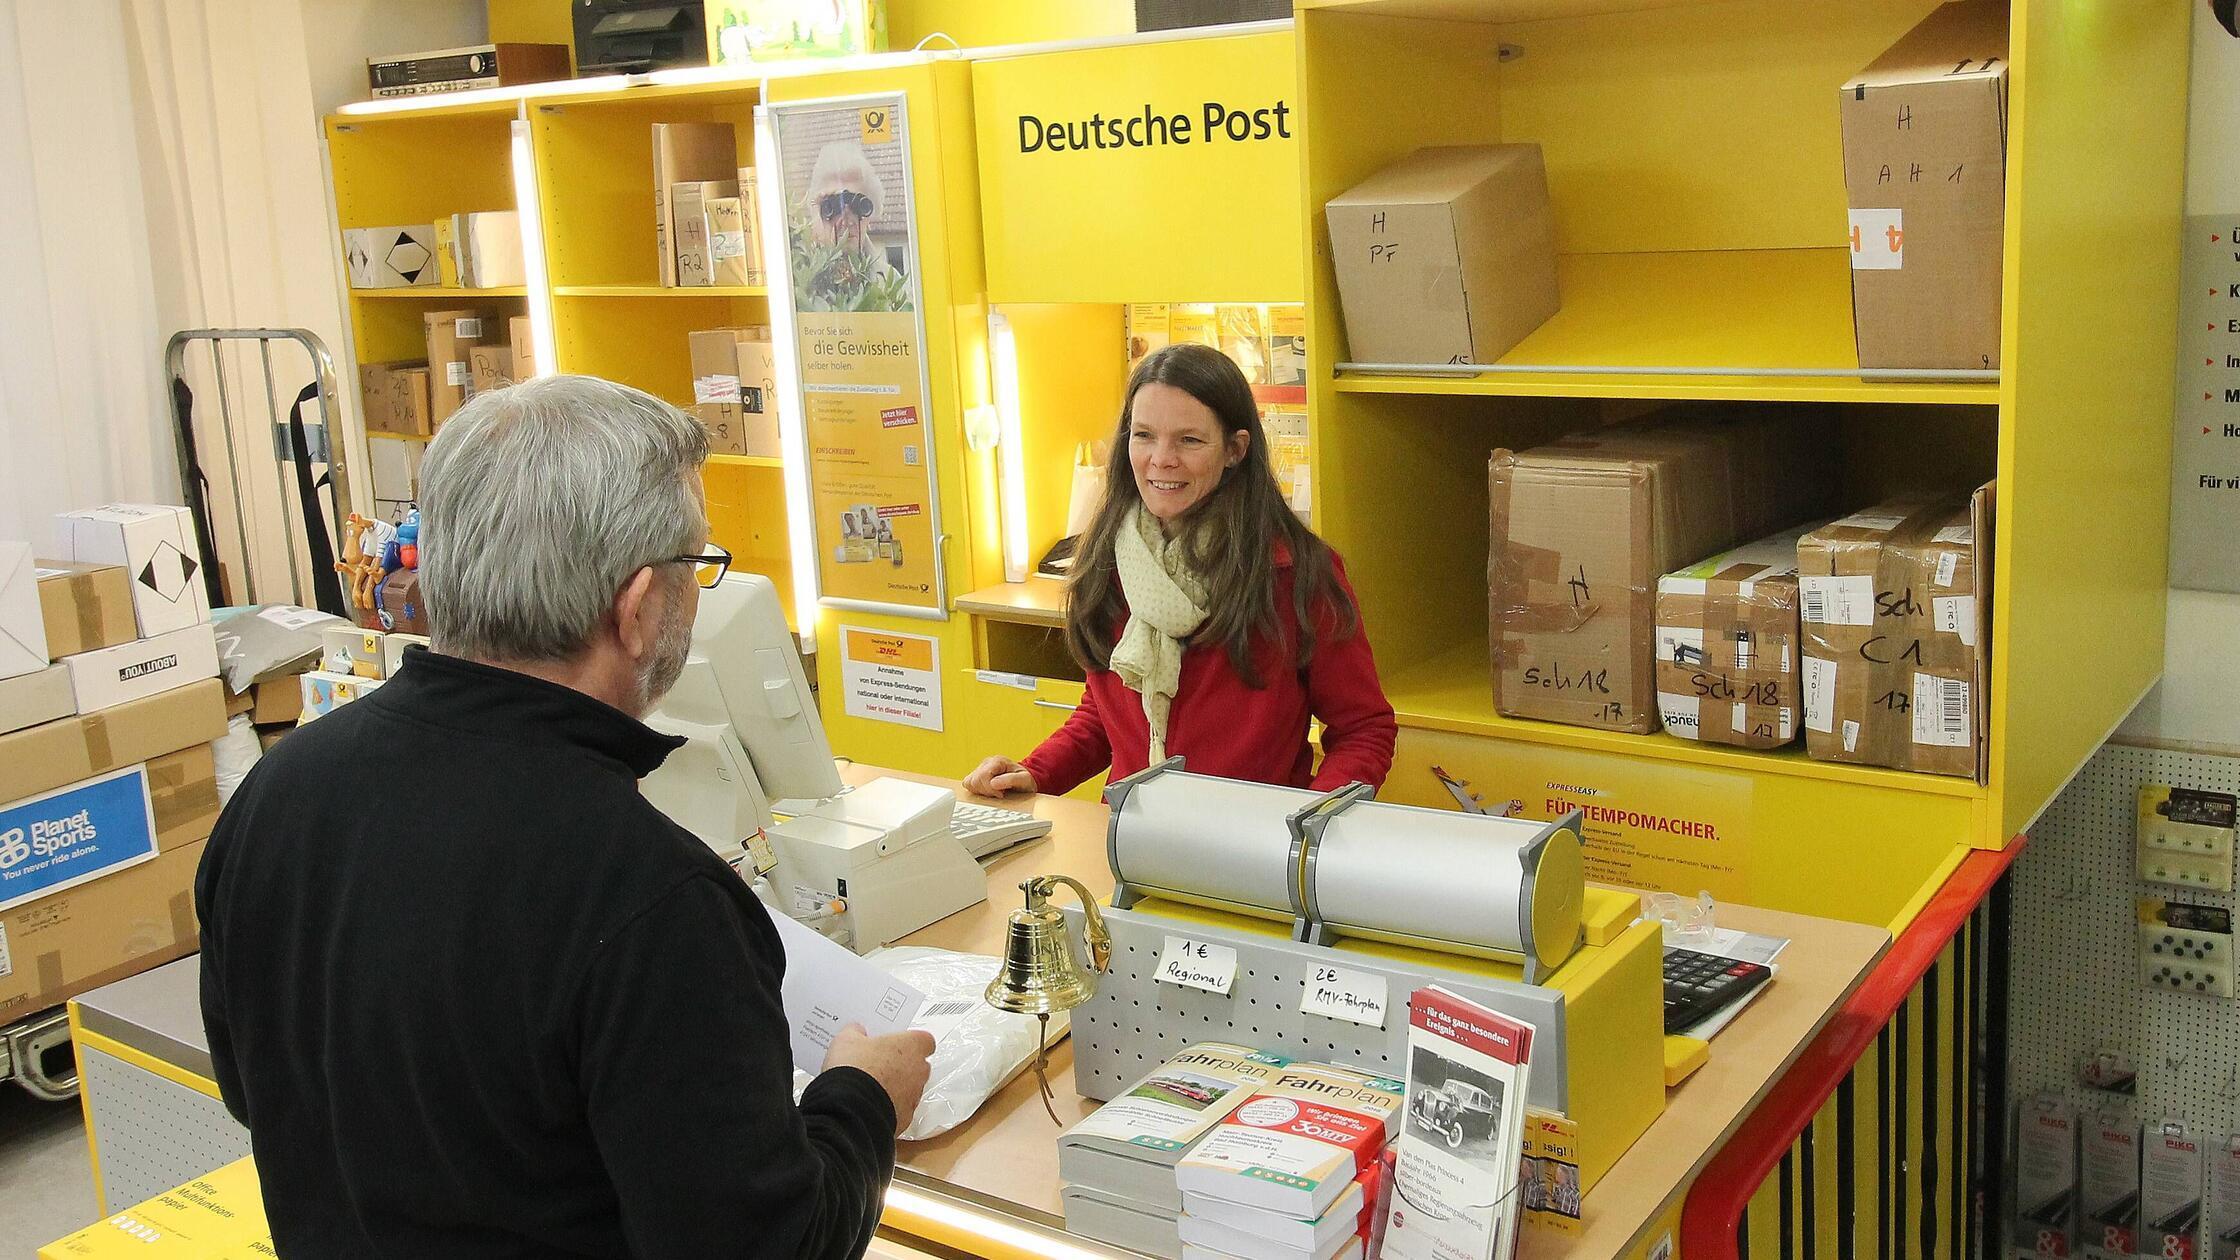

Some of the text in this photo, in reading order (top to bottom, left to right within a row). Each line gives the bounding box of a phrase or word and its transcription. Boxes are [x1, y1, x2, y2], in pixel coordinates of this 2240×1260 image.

[1897, 103, 1912, 130] H
[1019, 100, 1291, 153] Deutsche Post
[1372, 211, 1386, 234] H
[804, 327, 853, 336] Bevor Sie sich
[814, 340, 909, 357] die Gewissheit
[807, 361, 854, 371] selber holen.
[2200, 475, 2222, 489] Für
[880, 647, 897, 656] DHL
[147, 654, 177, 673] ABOUT
[878, 667, 904, 675] Annahme
[871, 678, 926, 693] Express-Sendungen
[1691, 673, 1780, 707] Sch 18
[857, 690, 930, 706] national oder international
[885, 707, 902, 716] dieser
[1546, 782, 1598, 796] EXPRESSEASY
[30, 808, 89, 836] Planet
[1581, 804, 1721, 842] TEMPOMACHER.
[33, 823, 97, 857] Sports
[3, 846, 99, 881] You never ride alone.
[1182, 941, 1209, 959] 1 €
[1166, 961, 1229, 988] Regional
[1315, 968, 1338, 982] 2€
[1438, 1011, 1451, 1023] das
[1452, 1015, 1470, 1031] ganz
[1470, 1022, 1510, 1047] besondere
[1276, 1075, 1391, 1107] Fahrplan
[192, 1181, 218, 1196] Office
[158, 1195, 189, 1212] papier
[175, 1187, 235, 1219] Multifunktions-
